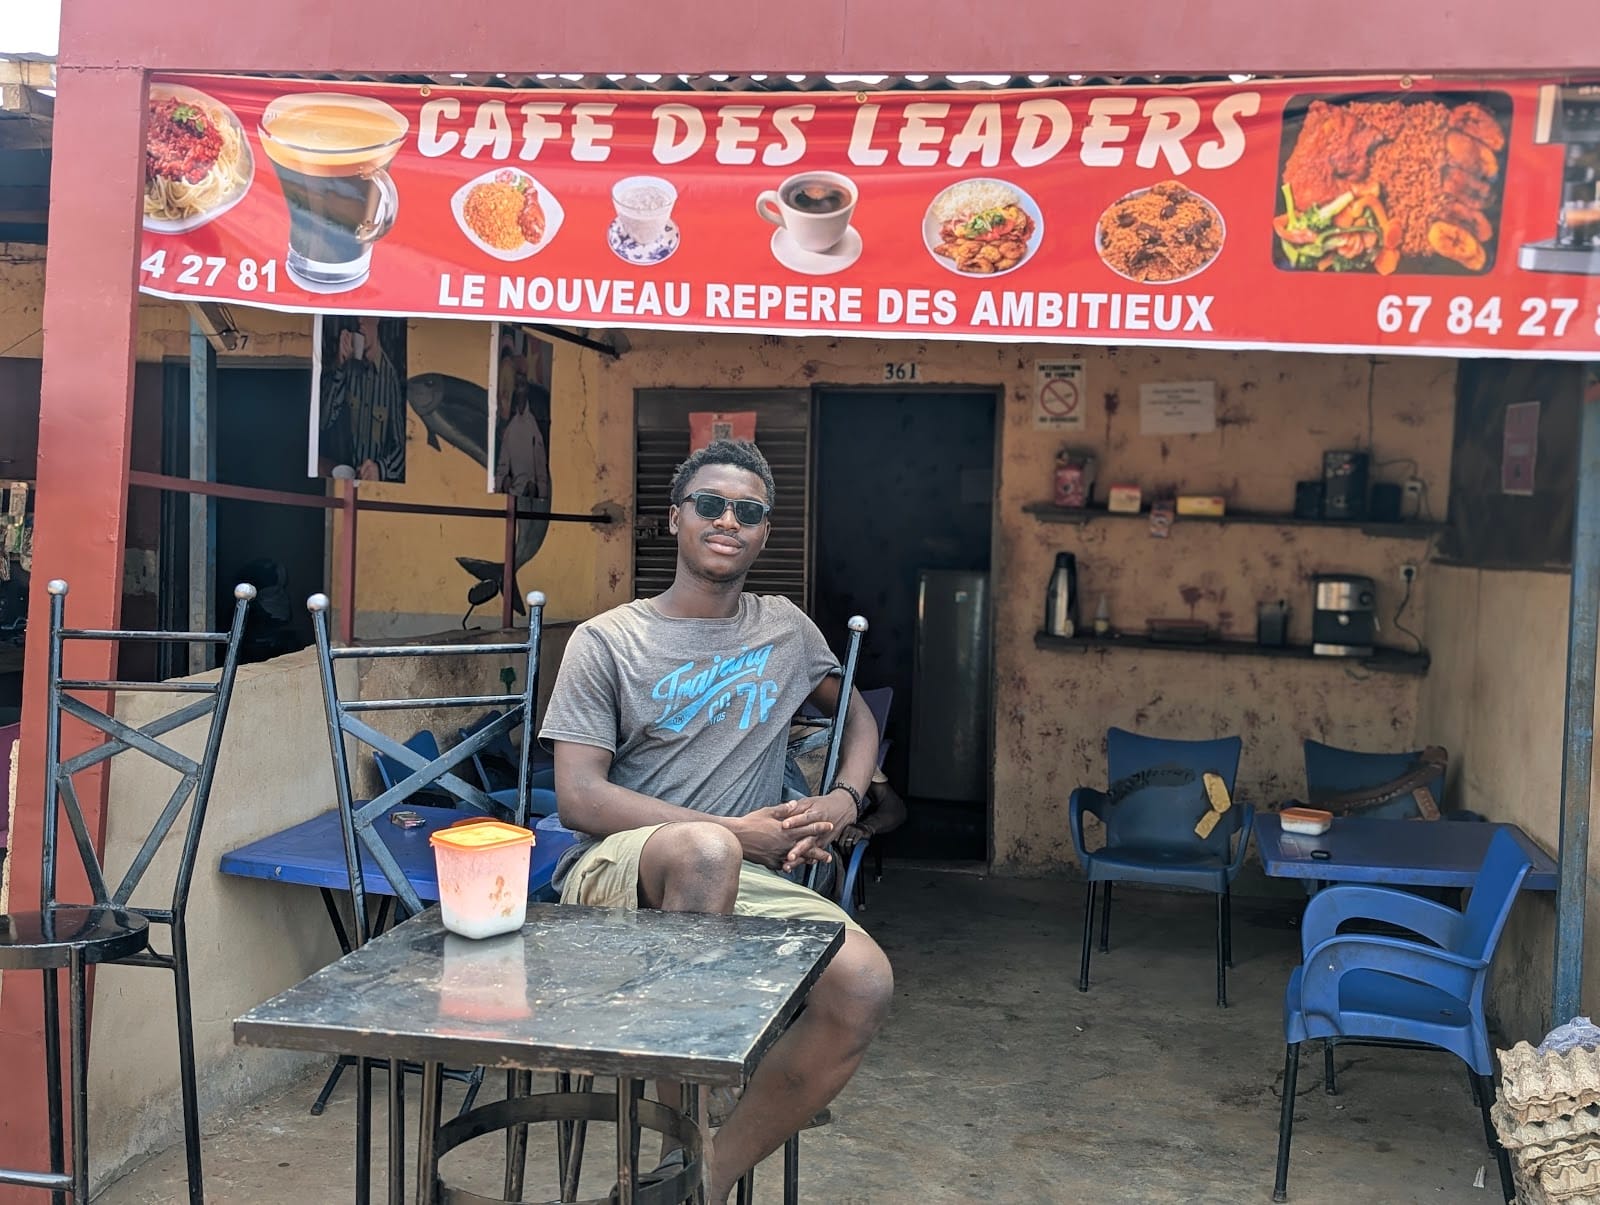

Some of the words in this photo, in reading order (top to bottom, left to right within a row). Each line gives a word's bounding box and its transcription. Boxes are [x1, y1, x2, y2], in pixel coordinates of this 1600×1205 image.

[417, 99, 615, 162] CAFE
[651, 103, 815, 167] DES
[847, 92, 1262, 175] LEADERS
[176, 254, 227, 287] 27
[237, 257, 278, 293] 81
[438, 273, 486, 308] LE
[498, 276, 690, 317] NOUVEAU
[706, 283, 863, 324] REPERE
[877, 288, 957, 327] DES
[970, 290, 1214, 332] AMBITIEUX
[1377, 294, 1432, 334] 67
[1446, 296, 1503, 336] 84
[1517, 297, 1579, 337] 27
[884, 362, 917, 380] 361
